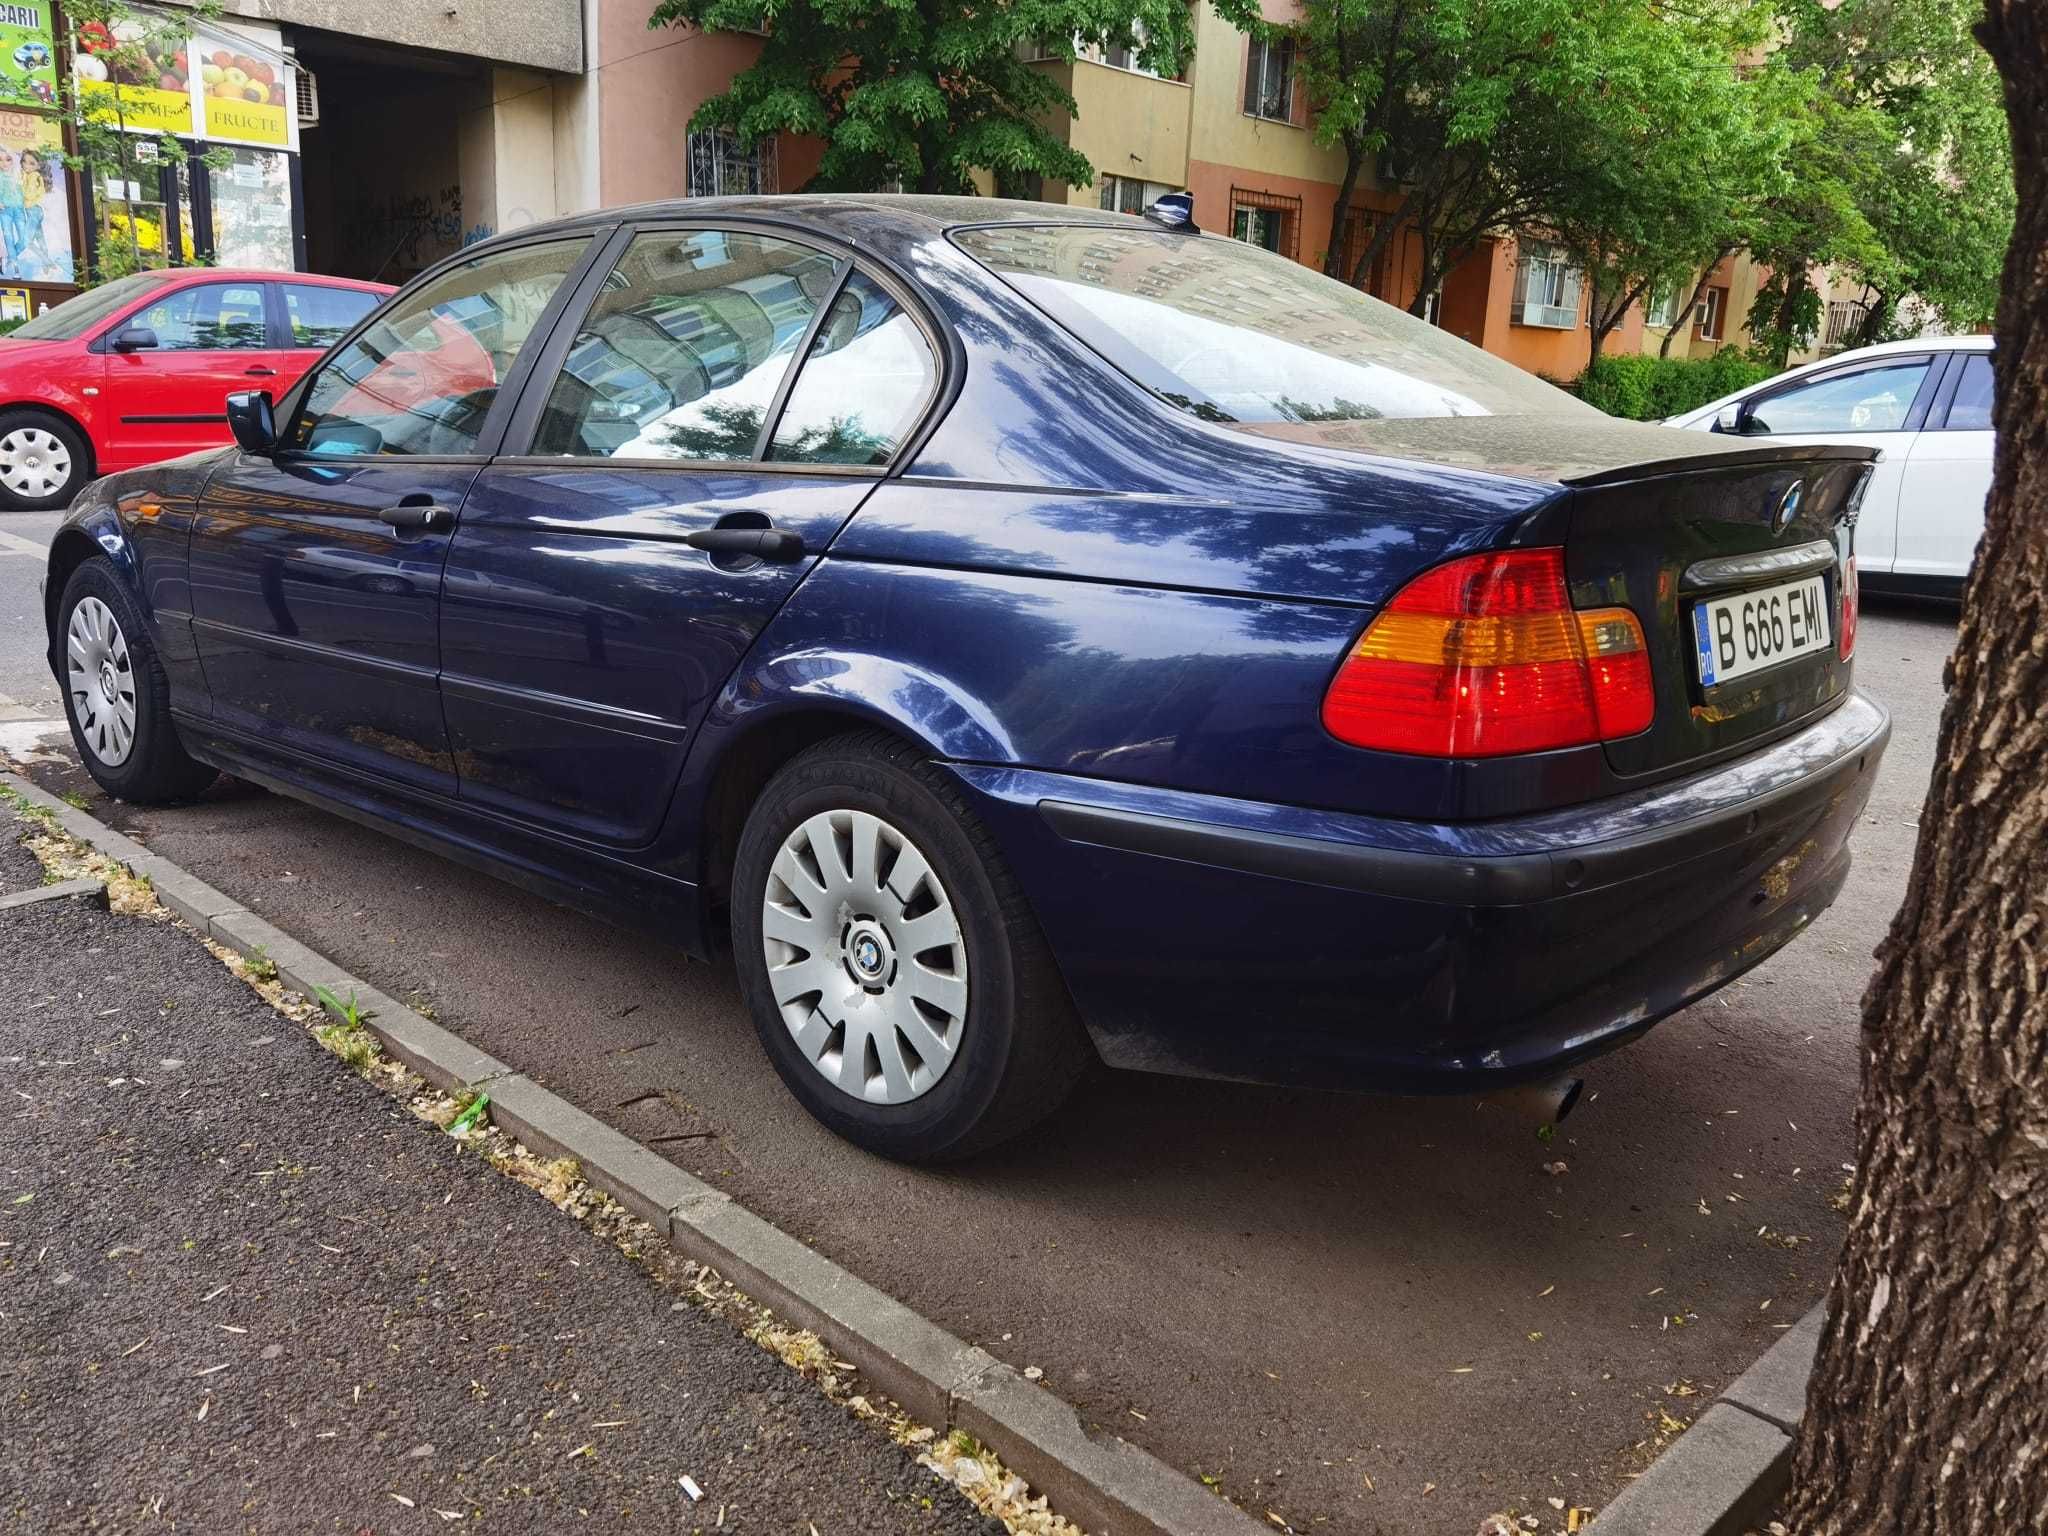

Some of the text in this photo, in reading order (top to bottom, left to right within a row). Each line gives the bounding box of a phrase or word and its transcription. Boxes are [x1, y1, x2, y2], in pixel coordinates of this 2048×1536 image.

[214, 111, 279, 132] FRUCTE
[1716, 585, 1822, 670] B 666 EMI
[1700, 652, 1713, 676] RO
